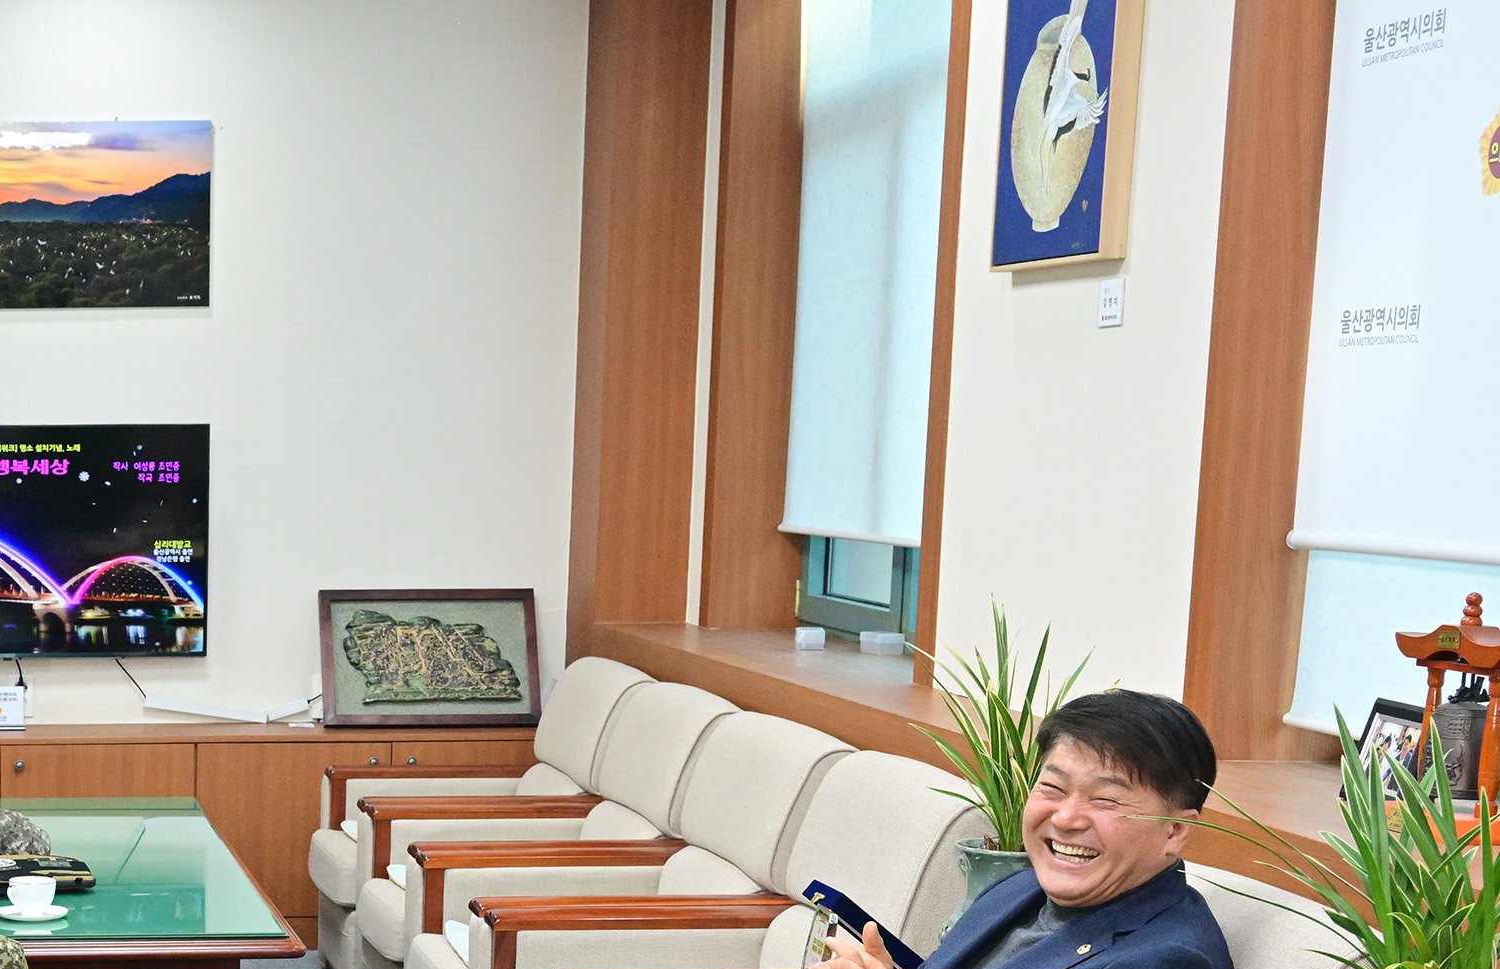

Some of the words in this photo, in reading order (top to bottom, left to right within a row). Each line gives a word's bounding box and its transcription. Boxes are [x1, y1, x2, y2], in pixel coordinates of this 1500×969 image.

[1363, 8, 1447, 54] 울산광역시의회
[1361, 56, 1379, 67] ULSAN
[1380, 45, 1419, 63] METROPOLITAN
[1420, 38, 1444, 53] COUNCIL
[1340, 304, 1421, 334] 울산광역시의회
[1339, 337, 1356, 347] ULSAN
[1356, 335, 1395, 346] METROPOLITAN
[1395, 334, 1418, 344] COUNCIL
[66, 444, 81, 453] 노래
[113, 461, 129, 471] 작사
[138, 473, 153, 483] 작곡
